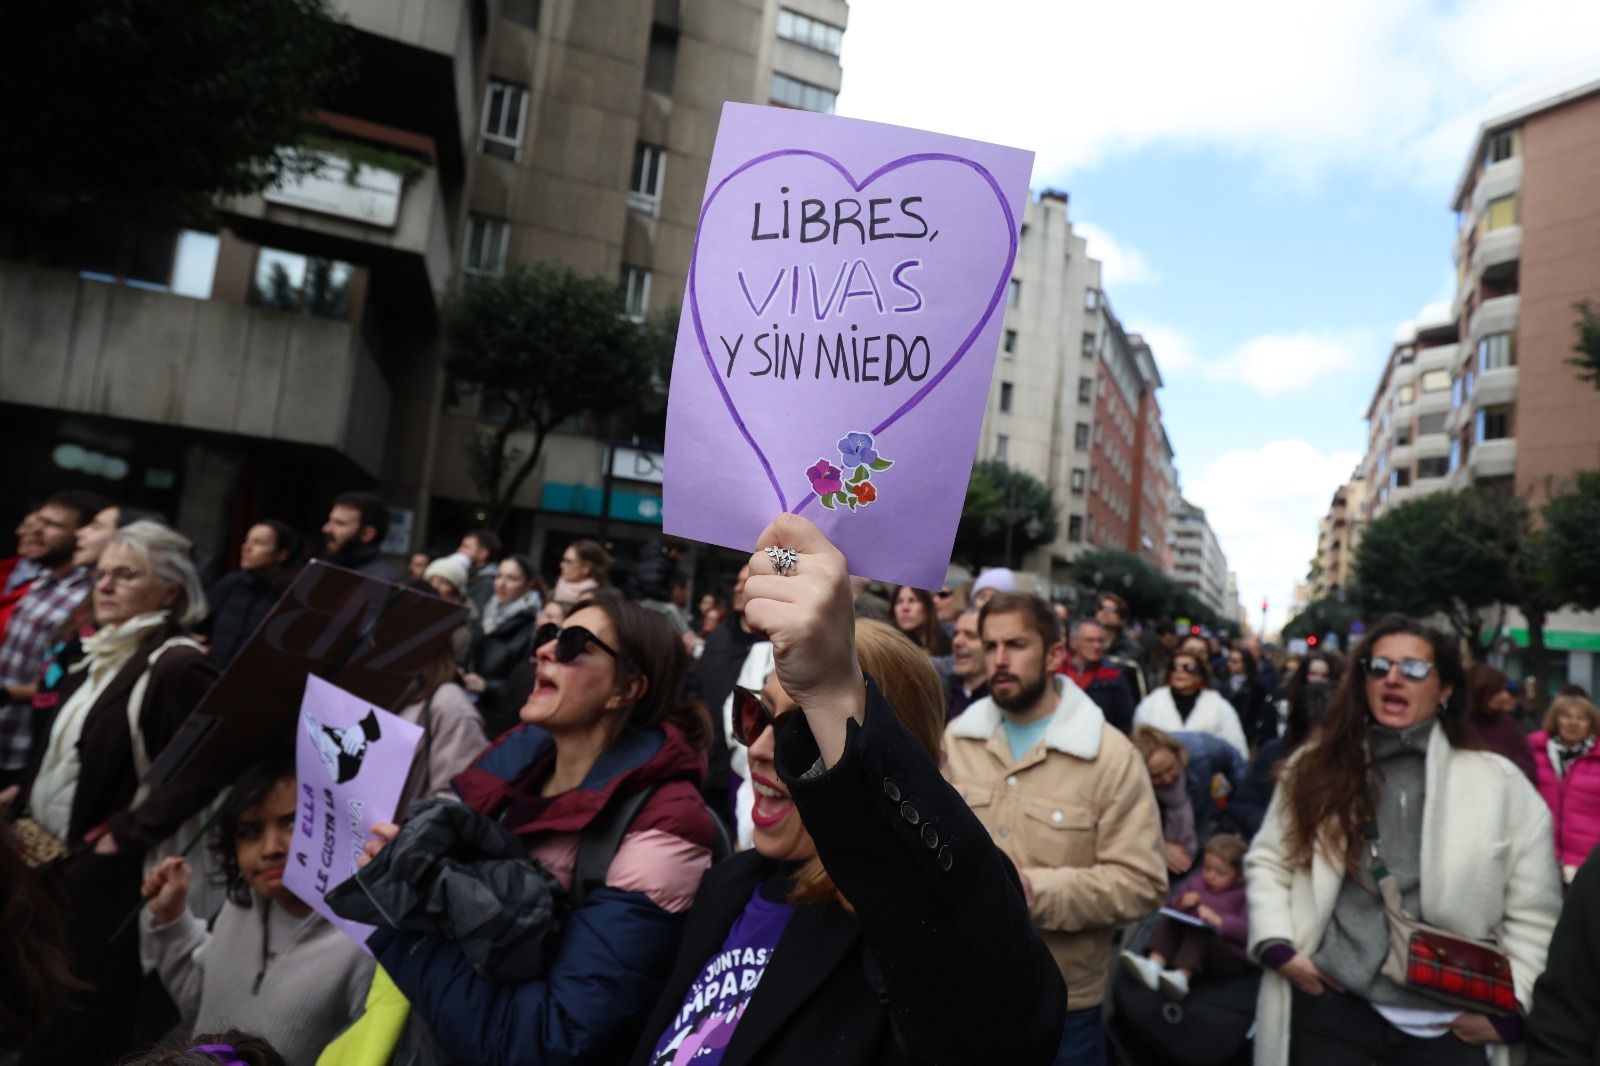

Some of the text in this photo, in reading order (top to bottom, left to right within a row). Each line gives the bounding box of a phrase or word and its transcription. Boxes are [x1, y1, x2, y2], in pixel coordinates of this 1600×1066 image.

[736, 257, 924, 322] VIVAS
[719, 323, 931, 386] Y SIN MIEDO
[296, 782, 315, 868] A ELLA
[314, 788, 337, 894] LE GUSTA LA
[704, 946, 767, 983] JUNTAS
